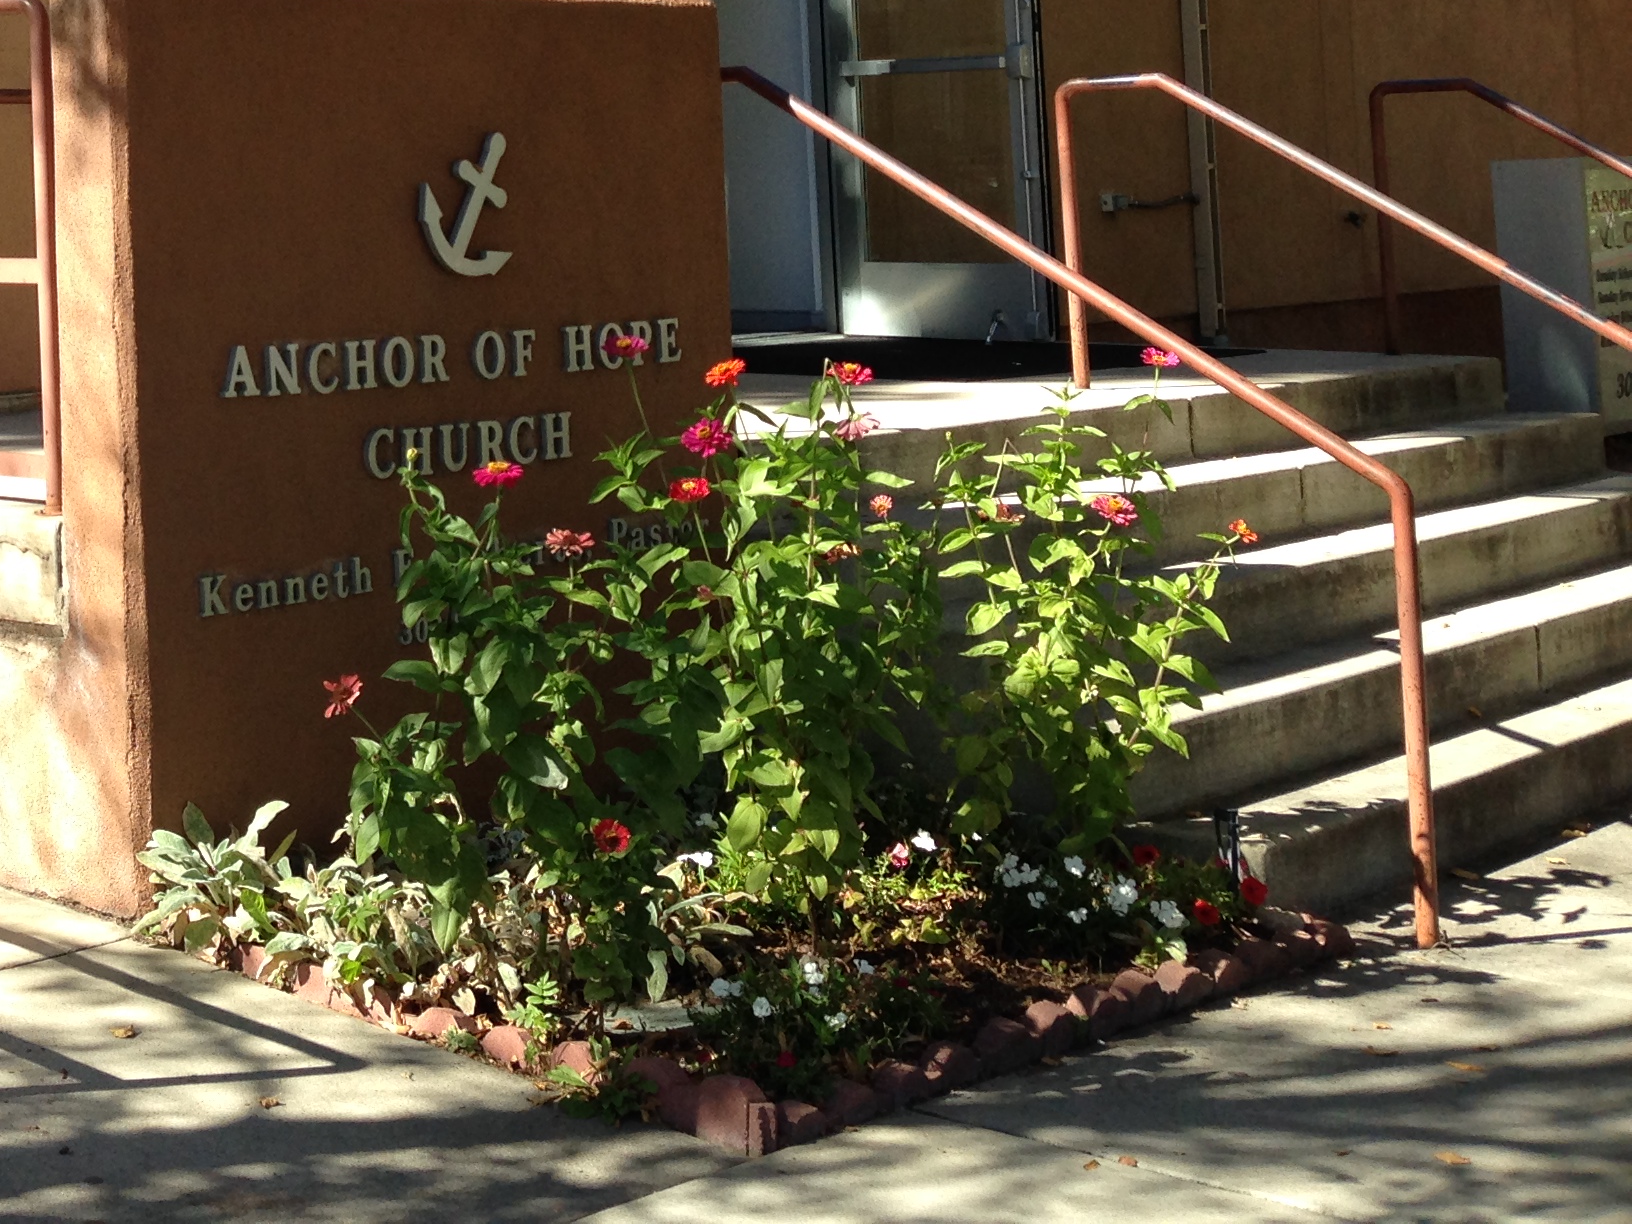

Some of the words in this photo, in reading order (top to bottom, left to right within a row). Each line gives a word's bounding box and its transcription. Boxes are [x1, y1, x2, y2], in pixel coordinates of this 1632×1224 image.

[224, 333, 450, 398] ANCHOR
[472, 328, 536, 381] OF
[563, 317, 683, 373] HOPE
[364, 411, 573, 480] CHURCH
[200, 556, 374, 618] Kenneth
